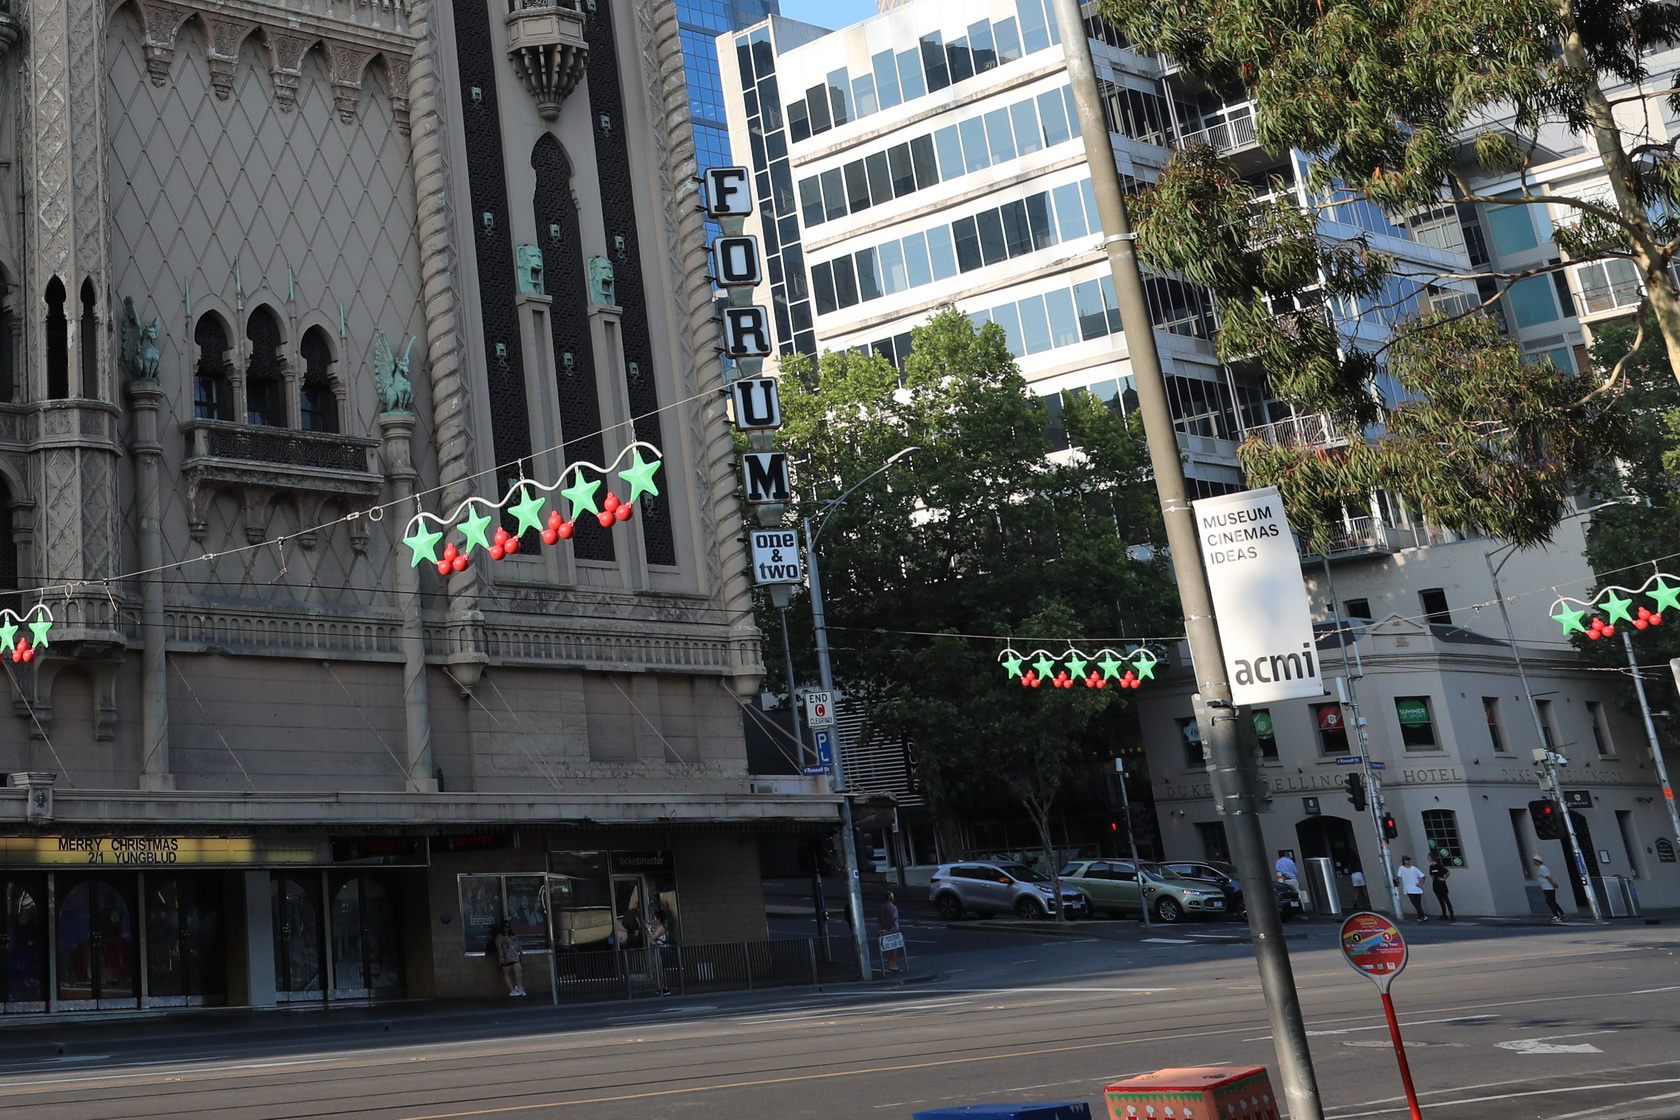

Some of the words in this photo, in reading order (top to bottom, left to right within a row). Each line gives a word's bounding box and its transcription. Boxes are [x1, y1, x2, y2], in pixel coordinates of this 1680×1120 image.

[713, 169, 790, 502] FORUM
[1203, 506, 1272, 529] MUSEUM
[756, 533, 795, 550] one
[1207, 524, 1279, 547] CINEMAS
[771, 549, 783, 563] &
[1210, 546, 1258, 565] IDEAS
[758, 561, 799, 580] two
[1234, 642, 1315, 686] acmi
[809, 694, 828, 704] END
[817, 704, 825, 716] C
[810, 717, 833, 725] CLEARWAY
[817, 734, 827, 749] P
[806, 766, 824, 774] Russell
[1166, 783, 1212, 798] DUKE
[1403, 768, 1462, 782] HOTEL
[58, 838, 102, 851] MERRY
[111, 838, 179, 851] CHRISTMAS
[88, 851, 104, 864] 2/1
[114, 851, 177, 864] YUNGBLUD
[619, 856, 665, 866] ticketmaster
